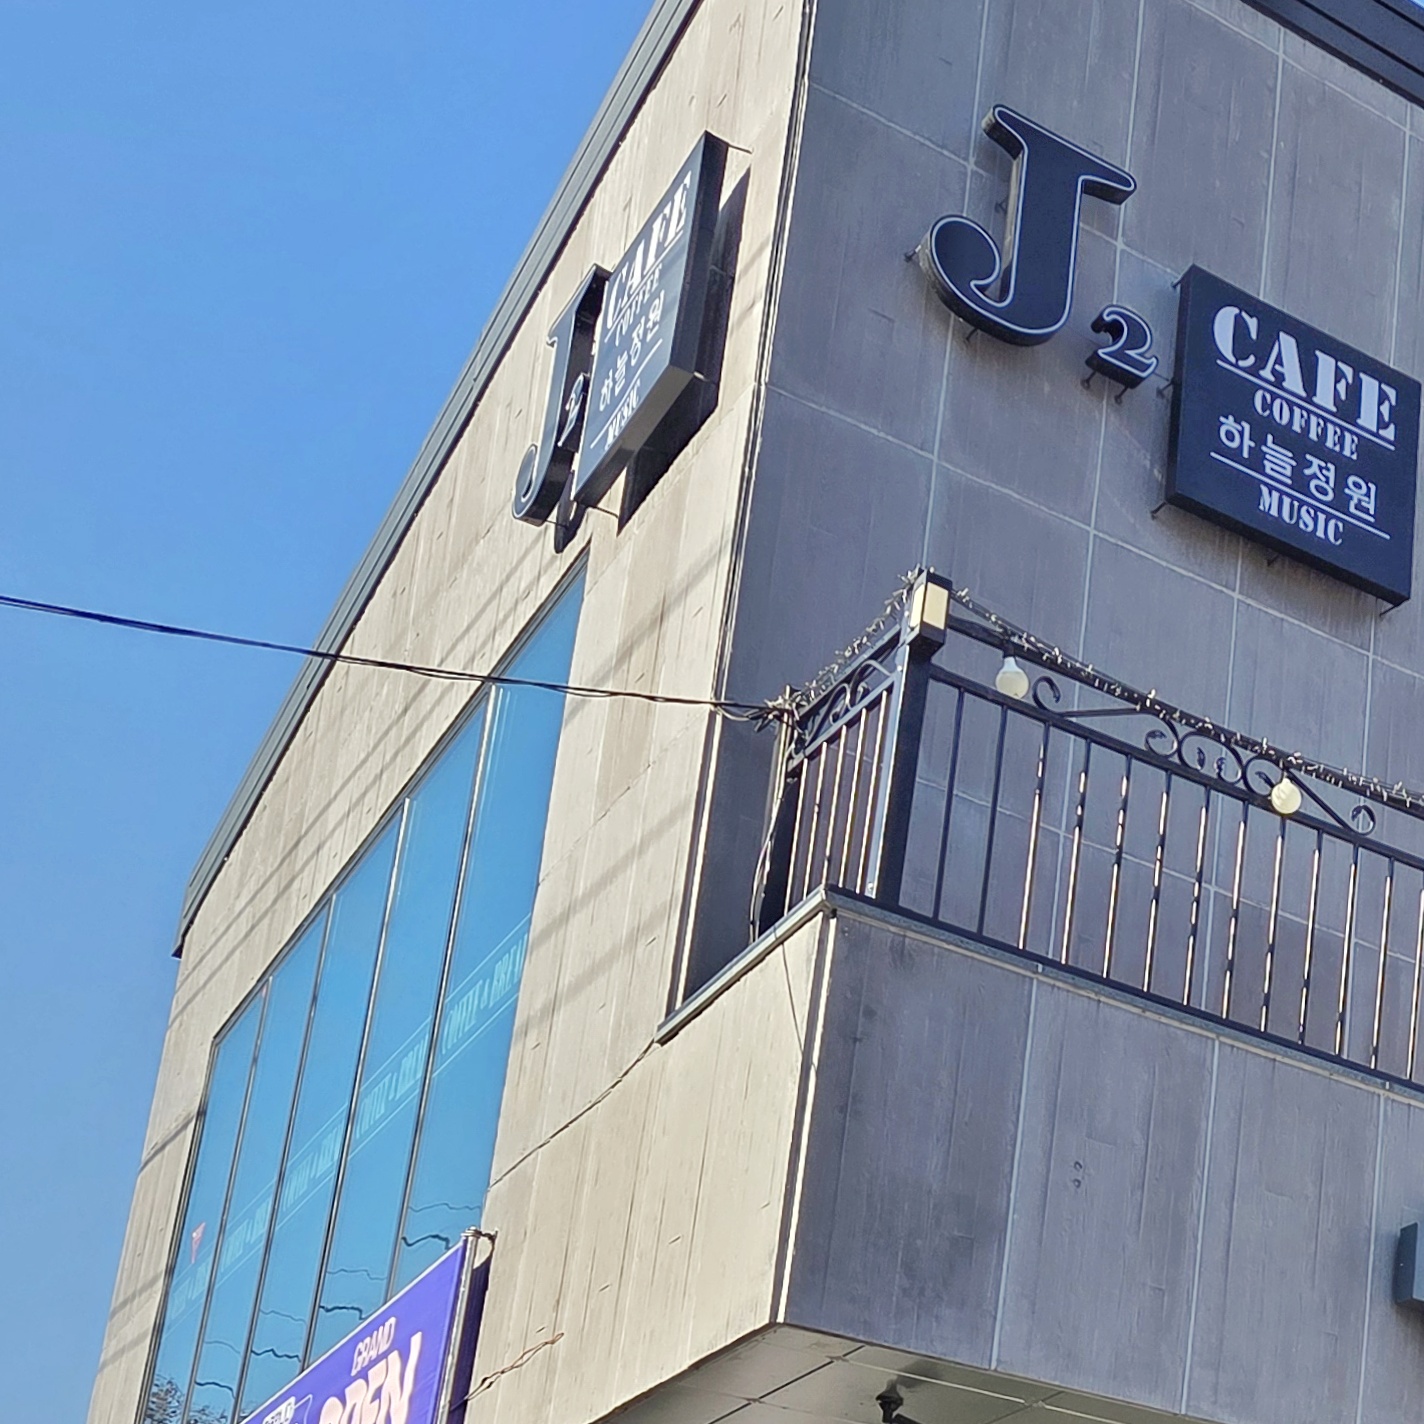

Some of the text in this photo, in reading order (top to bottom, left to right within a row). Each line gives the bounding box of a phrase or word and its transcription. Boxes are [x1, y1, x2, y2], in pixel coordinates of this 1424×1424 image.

[607, 170, 691, 329] CAFE
[922, 103, 1137, 347] J
[599, 289, 664, 412] 하늘정원
[615, 263, 662, 346] COFFEE
[604, 379, 641, 451] MUSIC
[1213, 306, 1397, 441] CAFE
[1219, 415, 1376, 523] 하늘정원
[1254, 389, 1358, 460] COFFEE
[1258, 485, 1344, 545] MUSIC
[351, 1317, 396, 1376] GRAND
